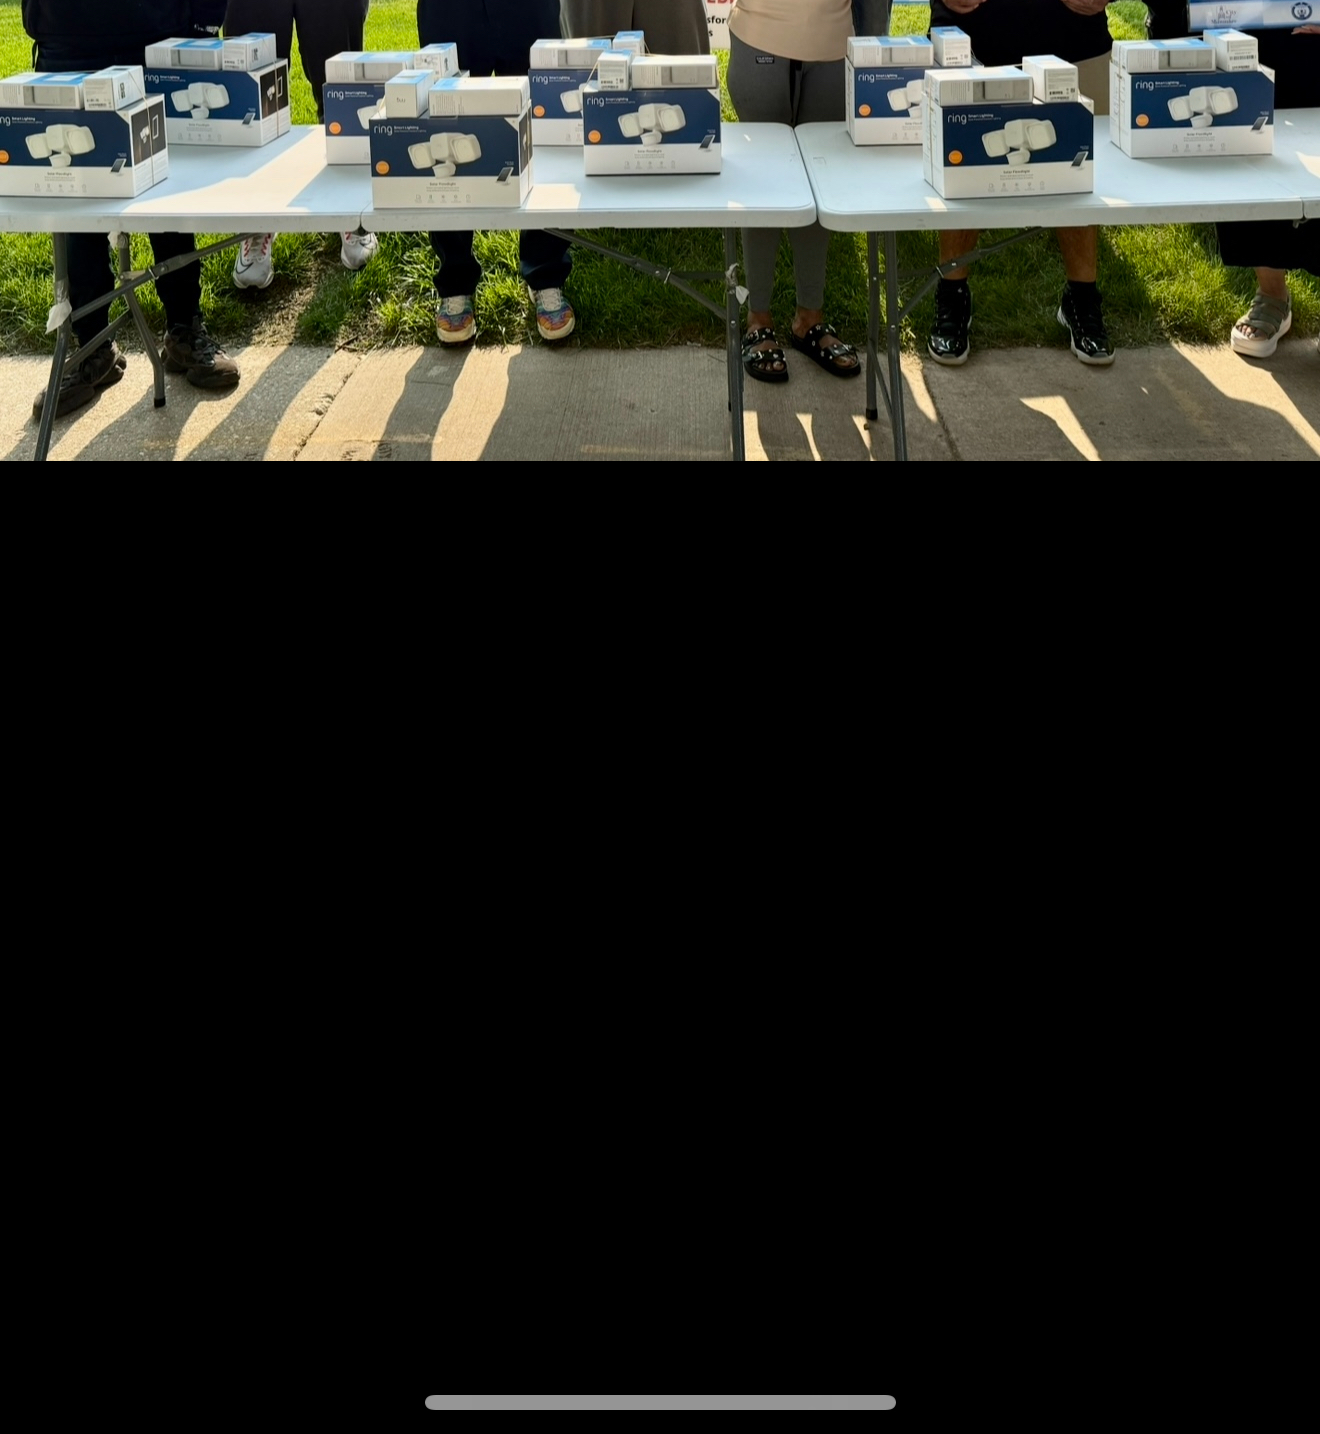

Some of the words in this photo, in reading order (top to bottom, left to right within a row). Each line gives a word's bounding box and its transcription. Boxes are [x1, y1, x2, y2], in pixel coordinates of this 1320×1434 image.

[144, 72, 160, 84] ring
[532, 74, 549, 85] ring
[858, 72, 875, 84] ring
[1136, 80, 1154, 92] ring
[326, 89, 344, 100] ring
[586, 96, 604, 107] ring
[0, 116, 10, 126] ng
[948, 112, 967, 125] ring
[374, 124, 393, 136] ring
